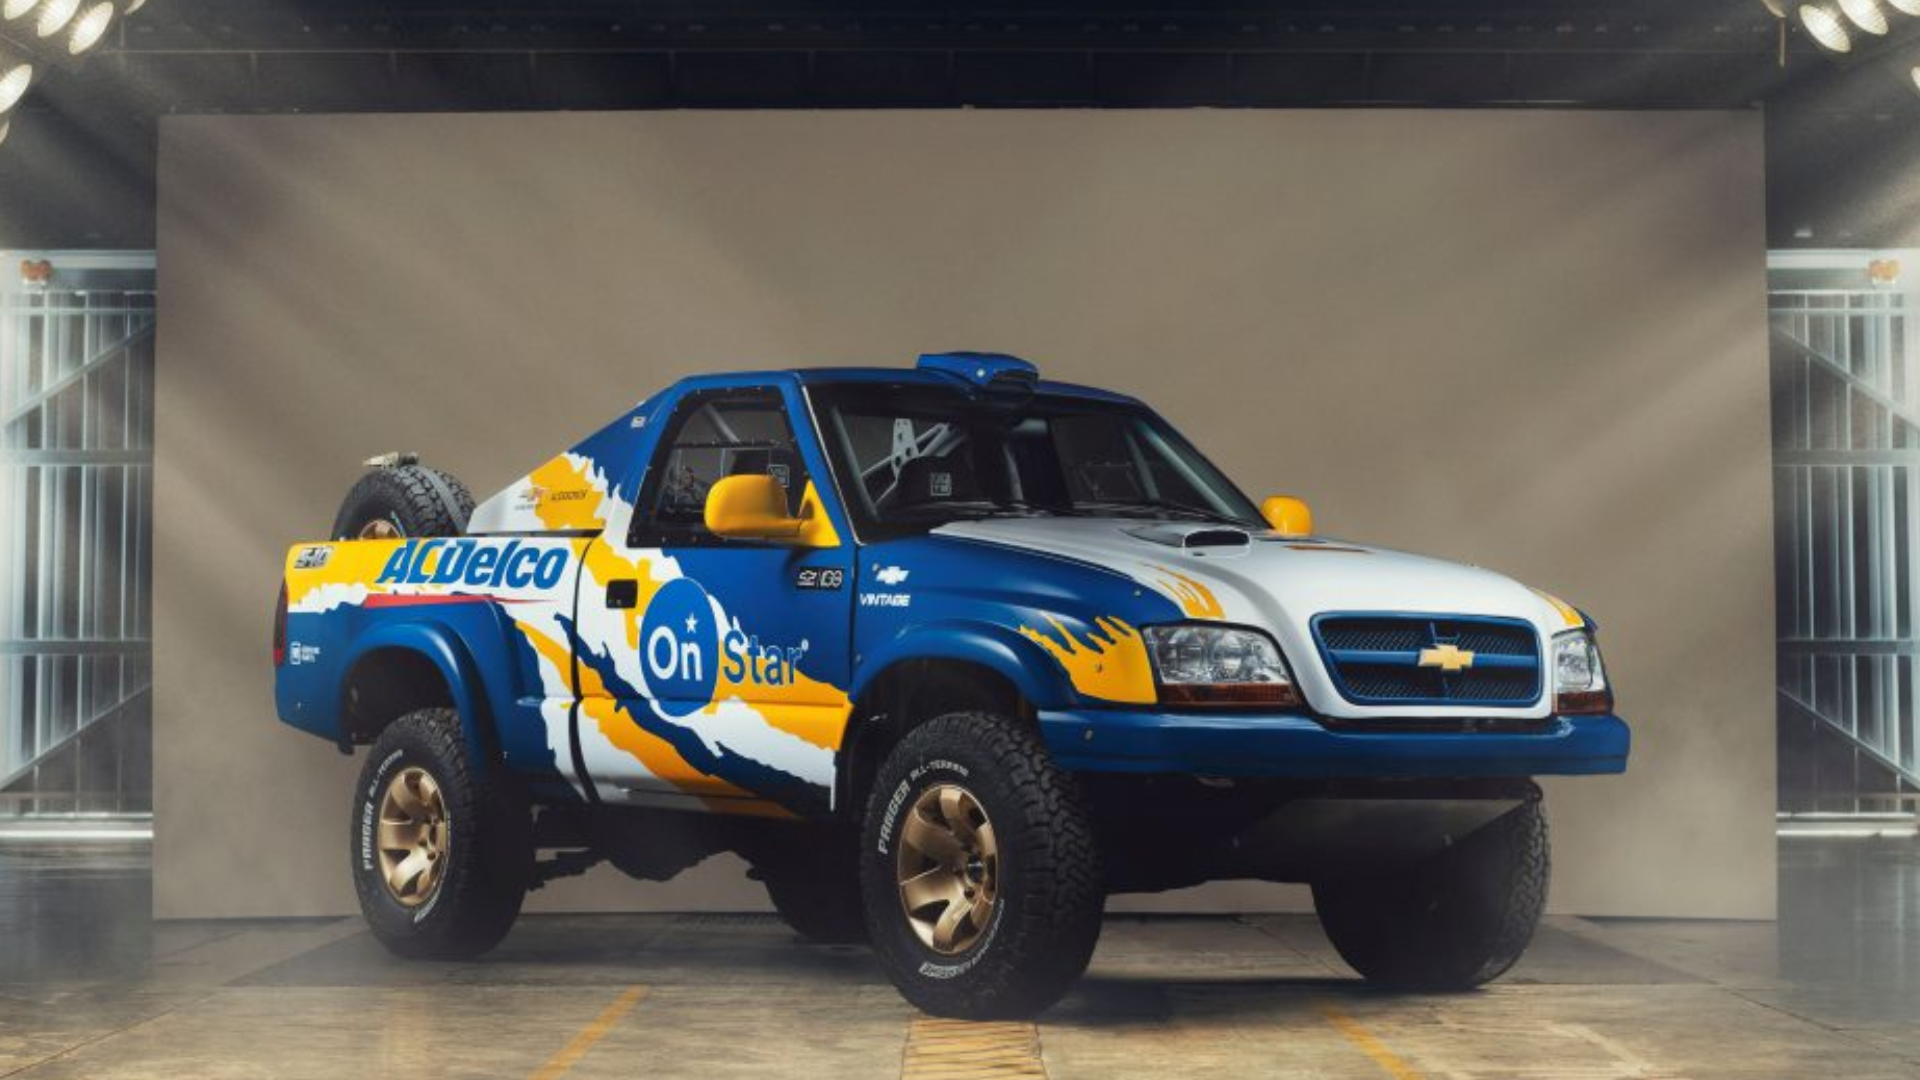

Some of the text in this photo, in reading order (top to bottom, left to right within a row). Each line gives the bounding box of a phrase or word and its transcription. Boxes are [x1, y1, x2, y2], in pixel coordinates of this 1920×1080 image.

[375, 539, 569, 589] ACDelco
[860, 593, 911, 606] VINTAGE
[647, 625, 703, 681] On
